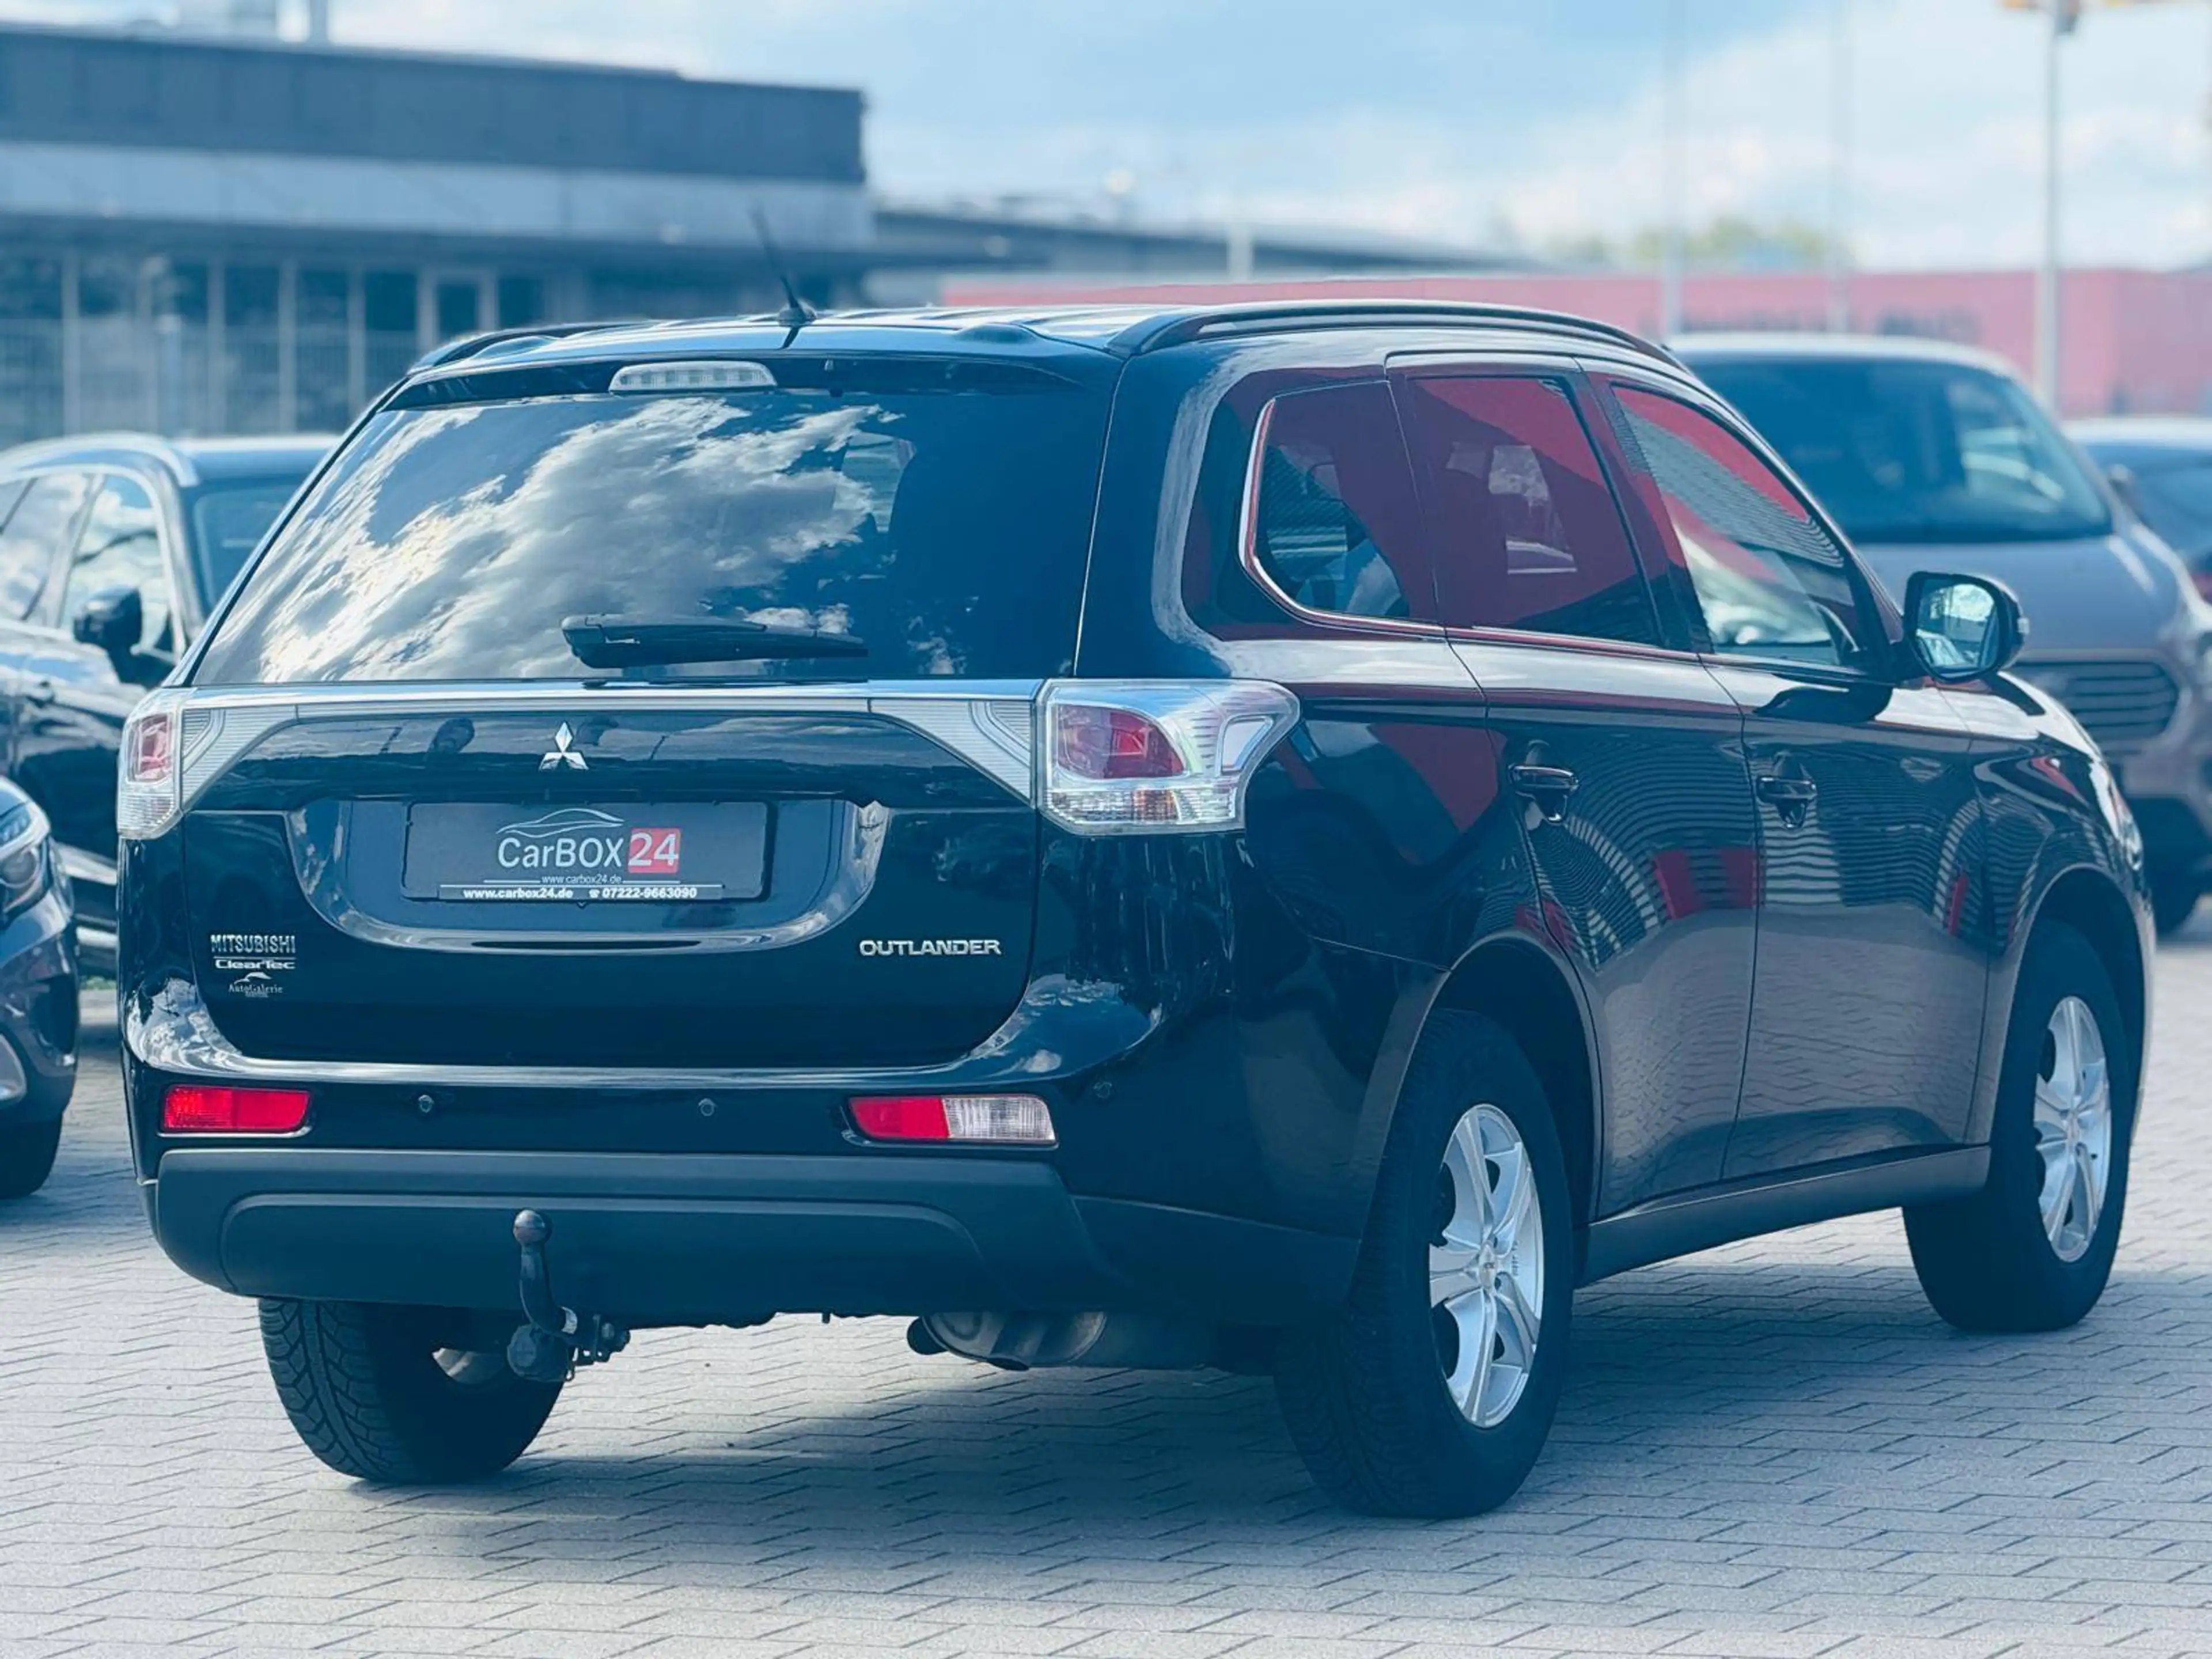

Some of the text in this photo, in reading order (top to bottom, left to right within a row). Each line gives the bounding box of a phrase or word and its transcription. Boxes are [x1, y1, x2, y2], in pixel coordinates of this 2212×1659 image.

[541, 873, 622, 884] www.carbox24.de
[463, 887, 574, 899] www.carbox24.de
[210, 934, 296, 953] MITSUBISHI
[859, 940, 1002, 956] OUTLANDER
[215, 959, 296, 969] ClearTec
